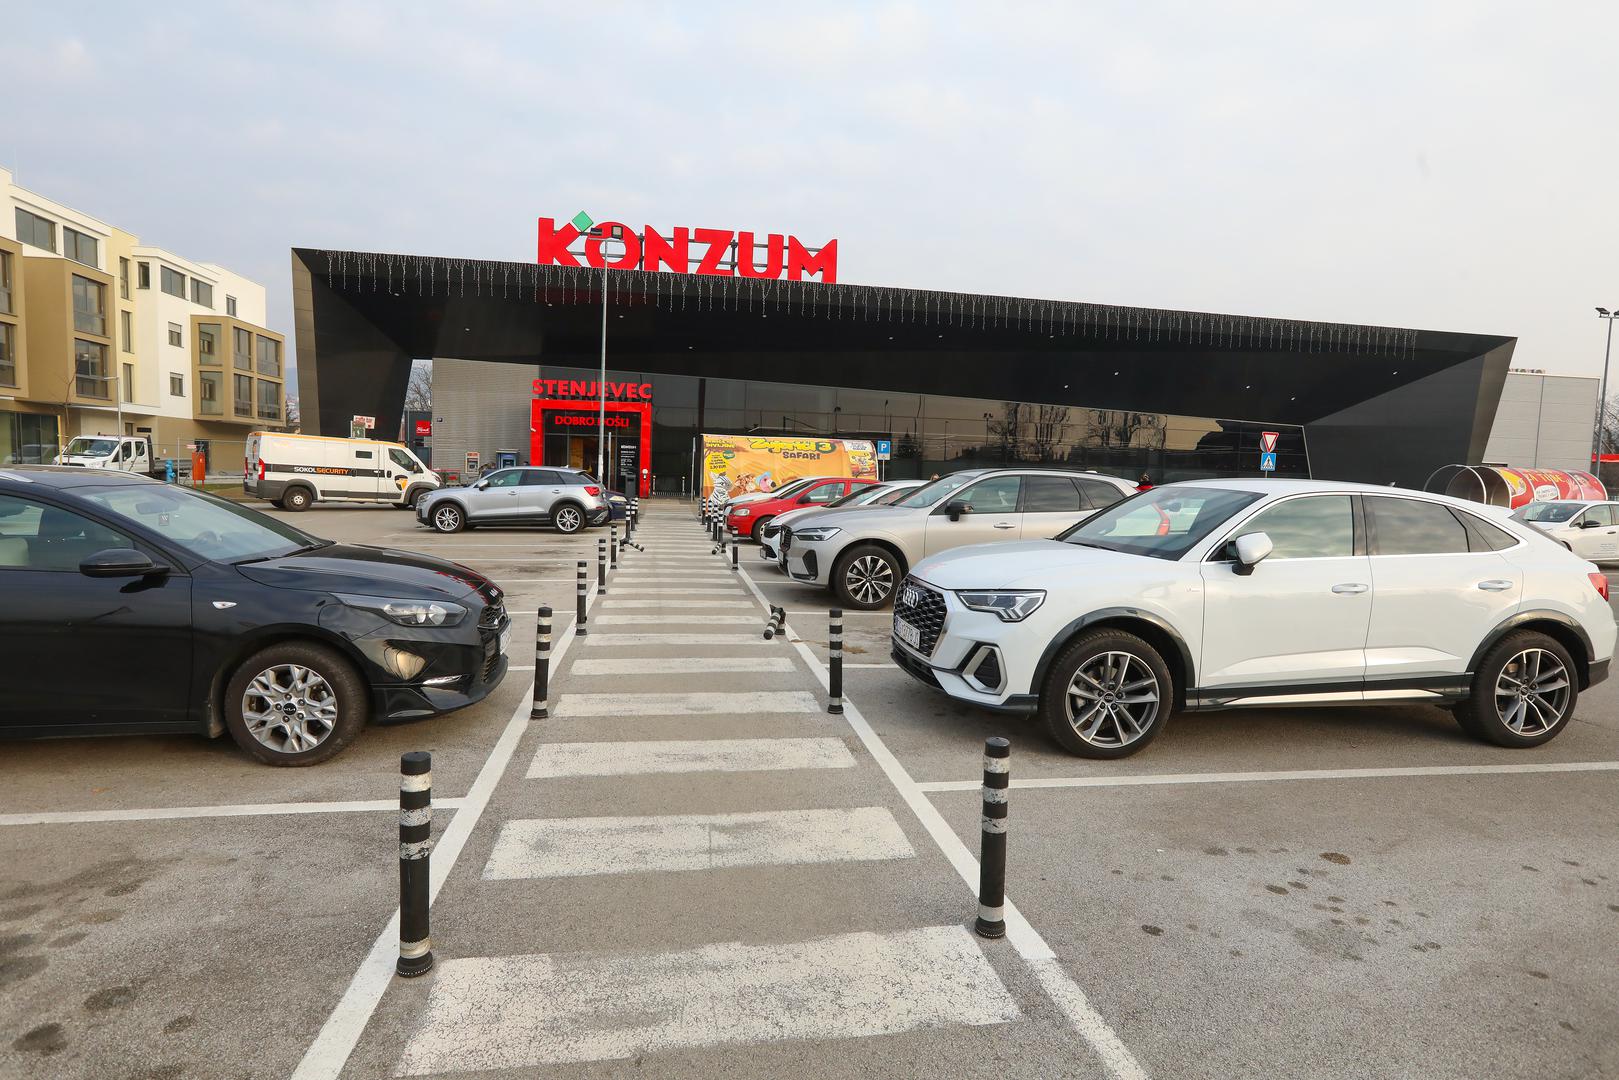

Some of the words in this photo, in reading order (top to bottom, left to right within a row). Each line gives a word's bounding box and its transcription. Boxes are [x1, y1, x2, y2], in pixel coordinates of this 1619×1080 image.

[538, 216, 838, 285] KONZUM
[531, 379, 652, 399] STENJEVEC
[555, 415, 595, 426] DOBRO
[880, 443, 887, 452] P
[782, 451, 821, 460] SAFARI
